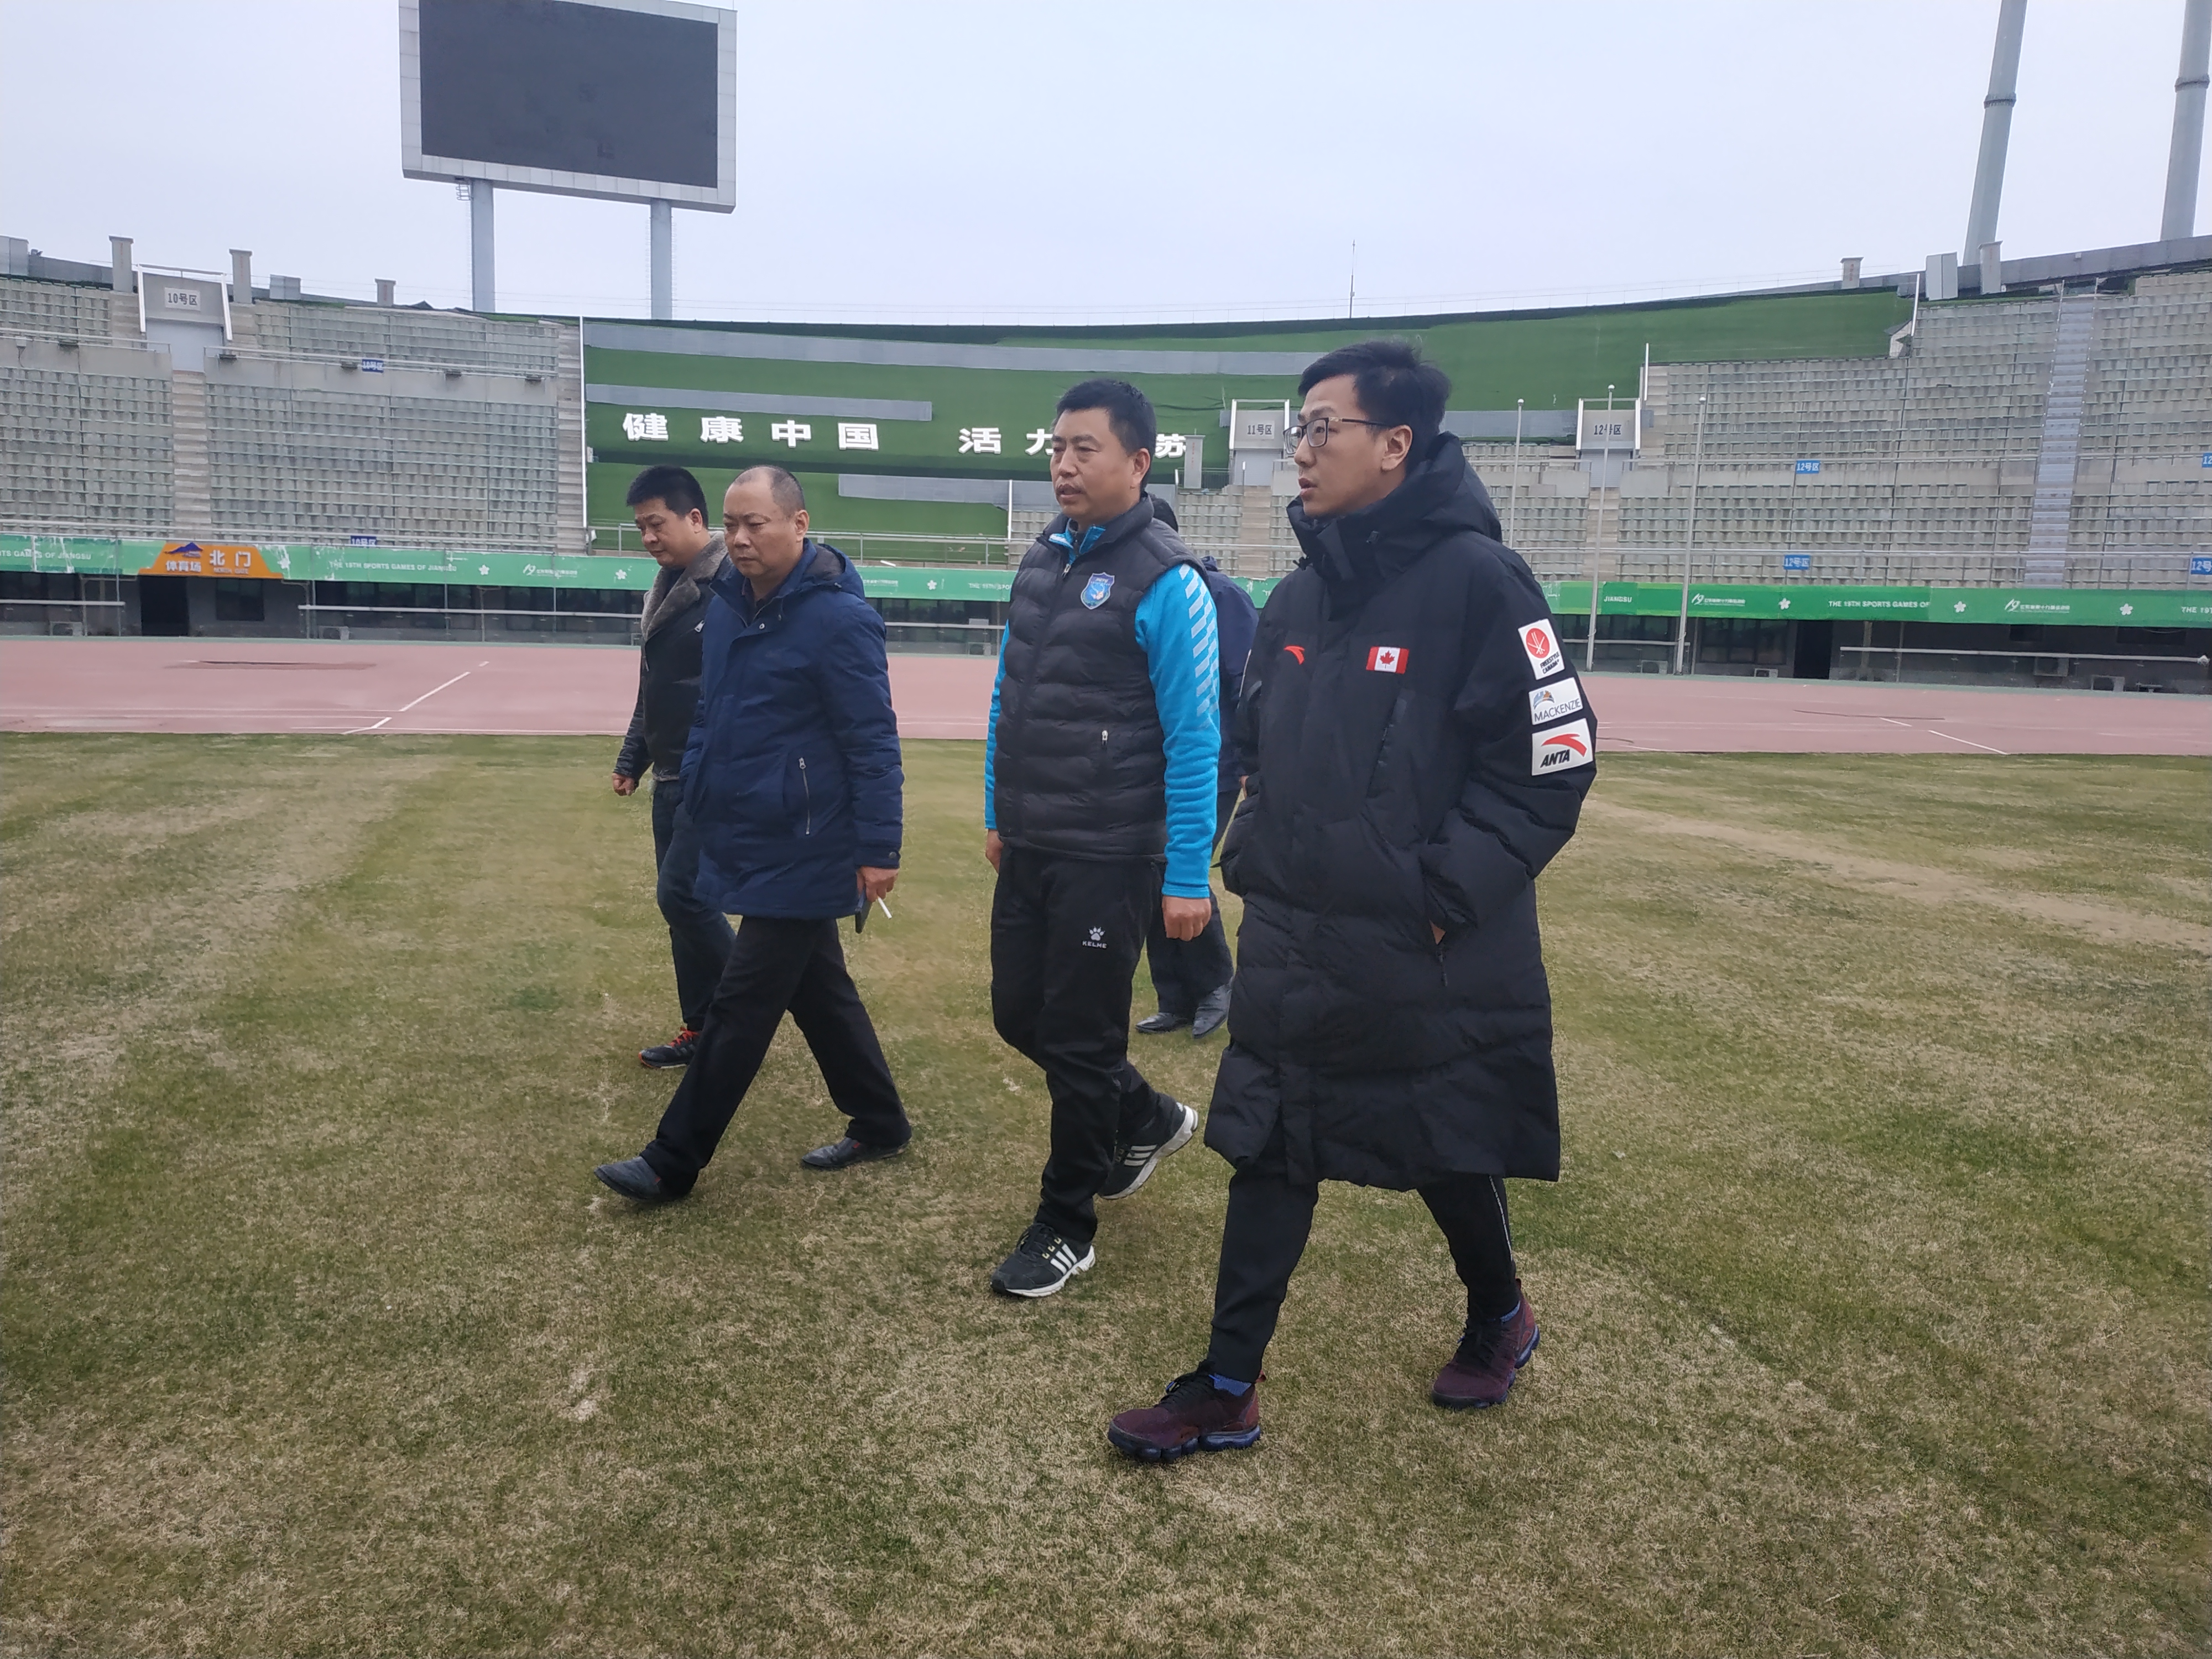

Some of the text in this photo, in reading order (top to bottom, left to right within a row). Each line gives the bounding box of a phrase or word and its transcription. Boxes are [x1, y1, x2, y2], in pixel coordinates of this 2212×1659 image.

[168, 293, 197, 305] 10号区
[623, 412, 879, 452] 健康中国
[1247, 424, 1272, 435] 11号区
[1594, 424, 1621, 435] 12号区
[1796, 462, 1819, 471] 12号区
[1785, 557, 1809, 567] 12号区
[1534, 698, 1581, 722] MACKENZIE
[1540, 749, 1570, 768] ANTA
